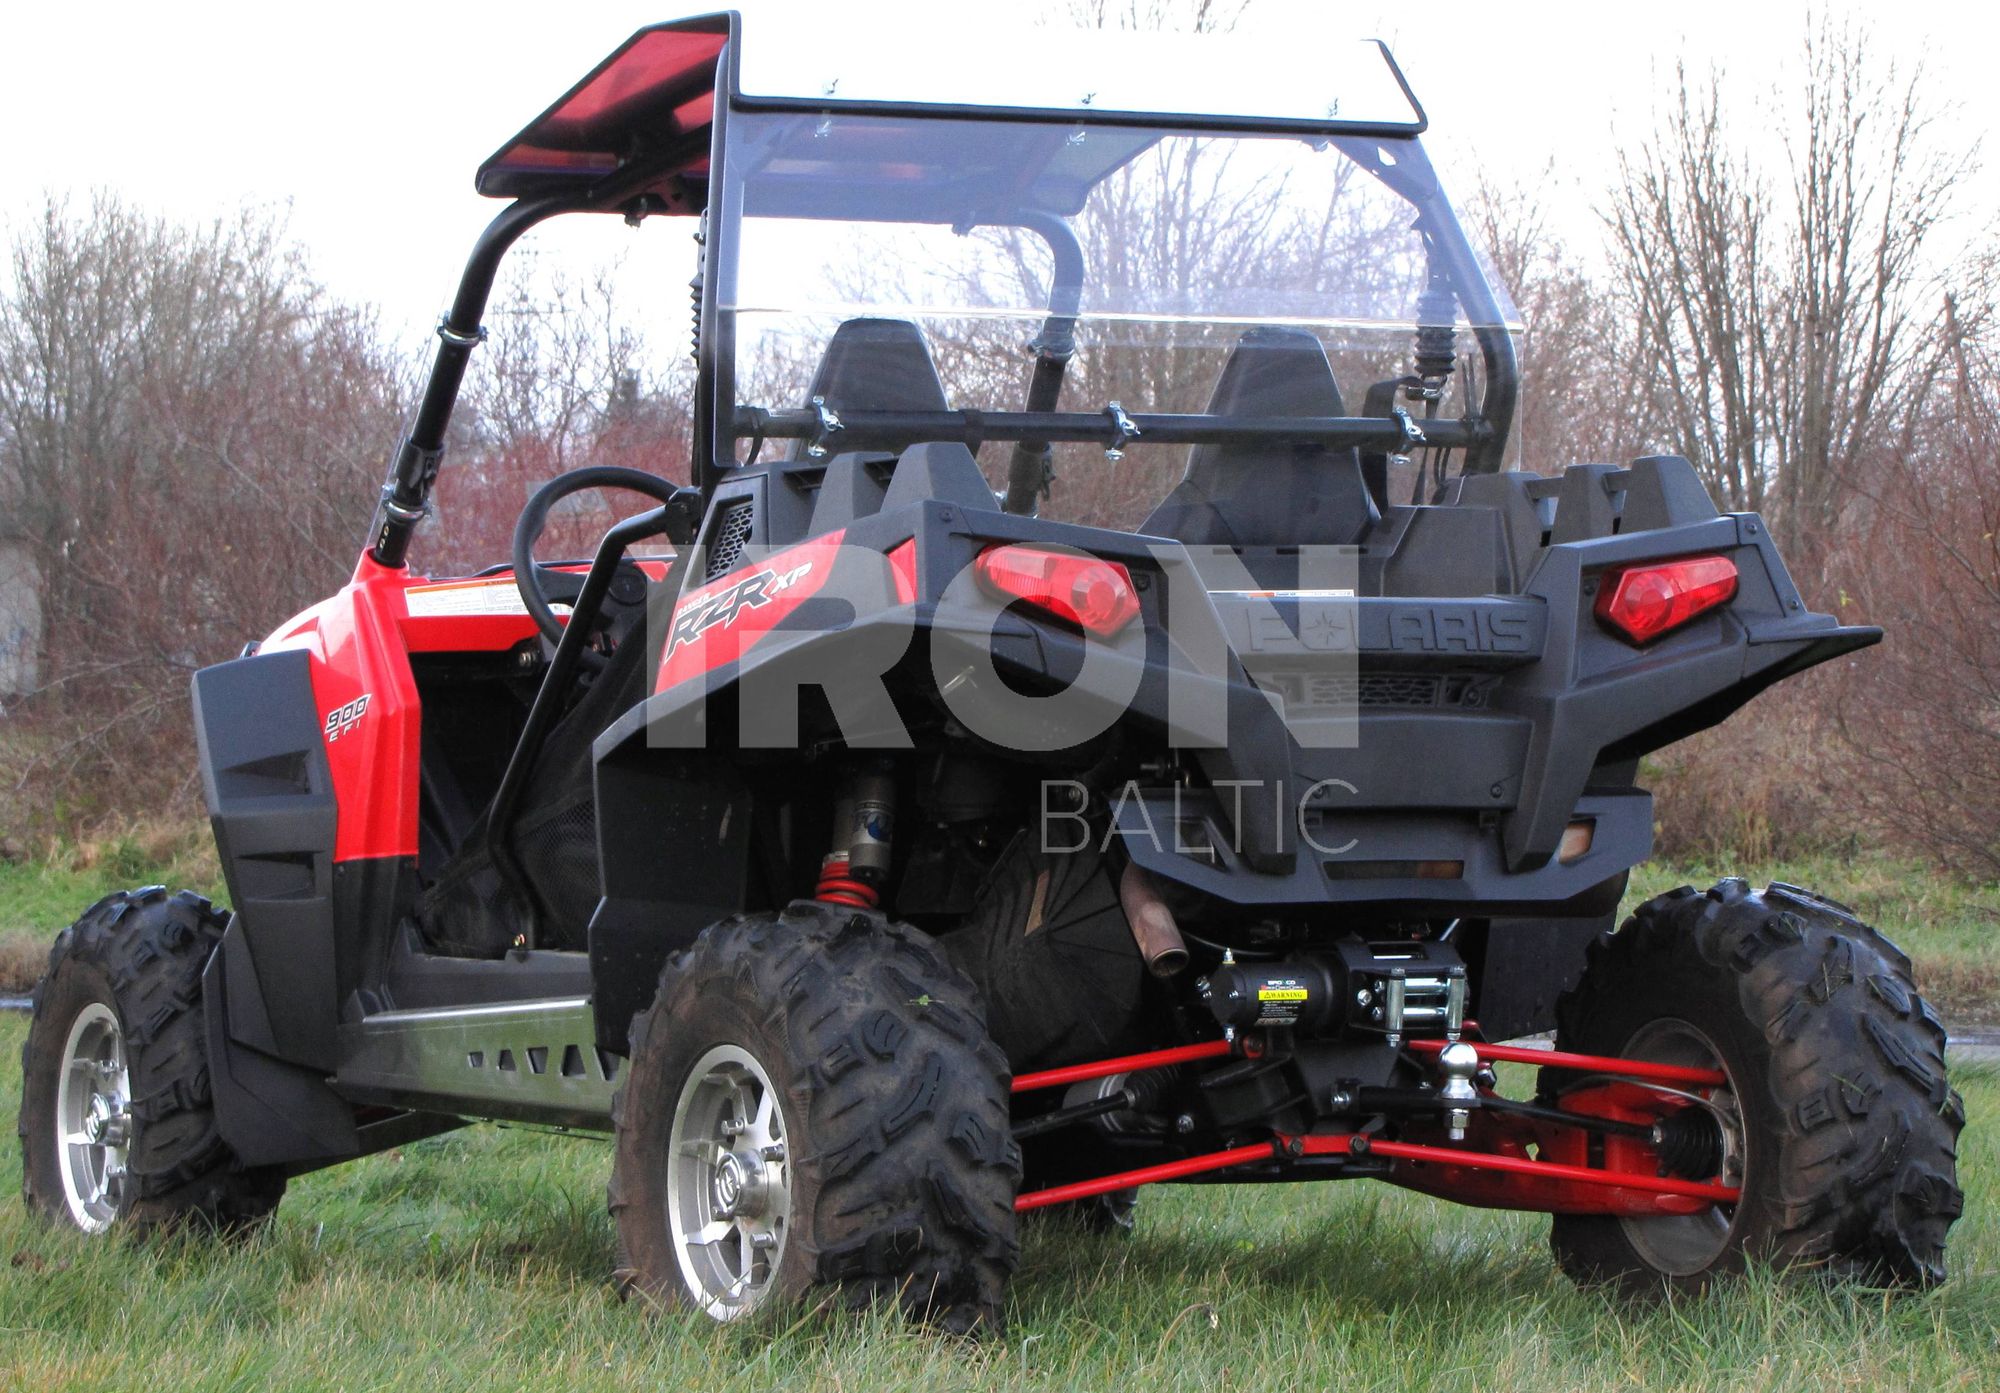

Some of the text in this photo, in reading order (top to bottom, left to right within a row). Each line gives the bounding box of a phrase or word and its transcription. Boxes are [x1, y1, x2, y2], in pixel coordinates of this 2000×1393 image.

[664, 561, 813, 665] RZR XP
[324, 693, 373, 735] 900
[329, 719, 361, 743] EFI
[1271, 991, 1303, 999] WARNING
